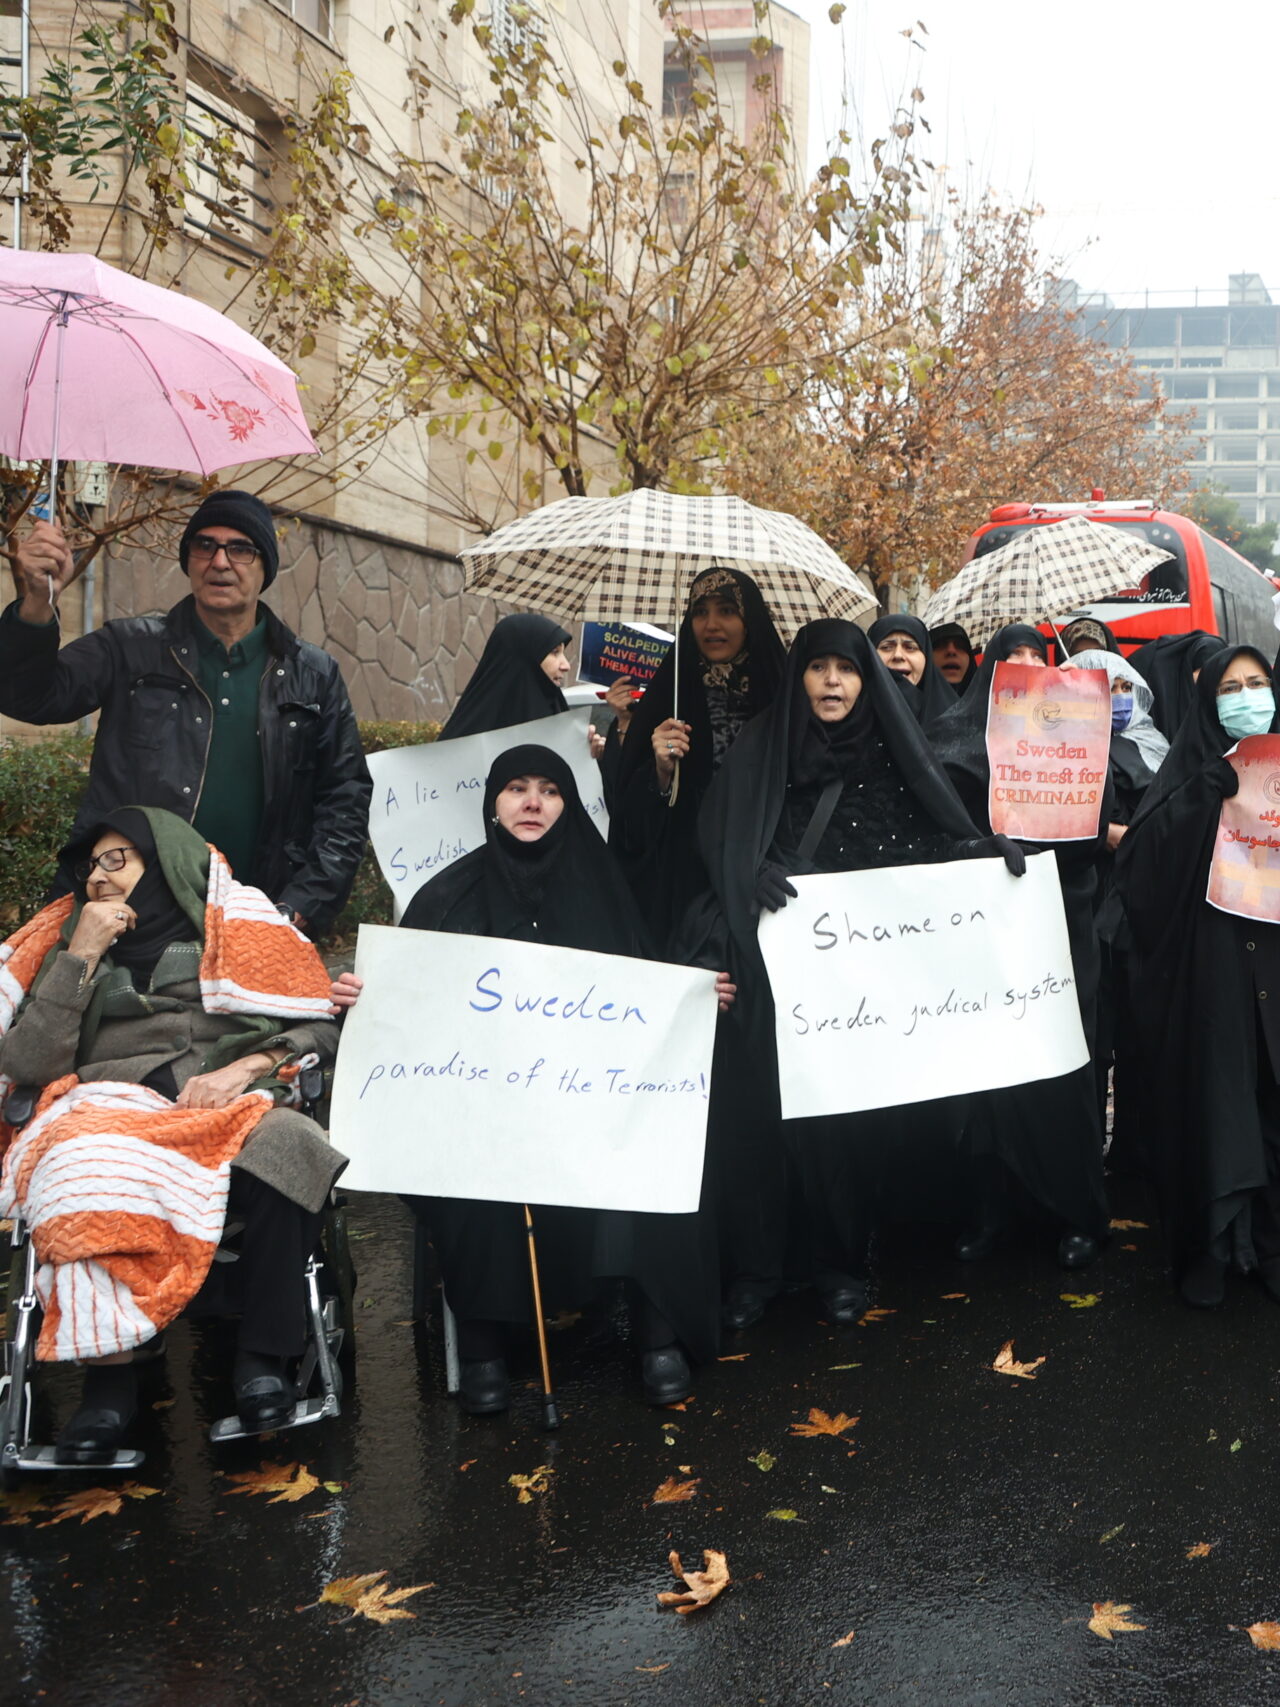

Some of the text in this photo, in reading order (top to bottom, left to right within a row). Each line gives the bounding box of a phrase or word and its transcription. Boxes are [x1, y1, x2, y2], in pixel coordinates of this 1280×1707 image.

[603, 645, 663, 668] ALIVE AND
[604, 631, 660, 653] SCALPED
[599, 656, 656, 680] THEM ALIV
[1016, 740, 1088, 760] Sweden
[996, 764, 1104, 785] The nest for
[385, 786, 400, 817] A
[415, 781, 440, 805] lie
[994, 787, 1098, 806] CRIMINALS
[390, 838, 470, 882] Swedish
[812, 909, 986, 950] Shame on
[468, 967, 647, 1025] Sweden
[792, 996, 888, 1035] Sweden
[359, 1050, 490, 1100] paradise
[506, 1057, 546, 1089] of
[558, 1067, 593, 1094] the
